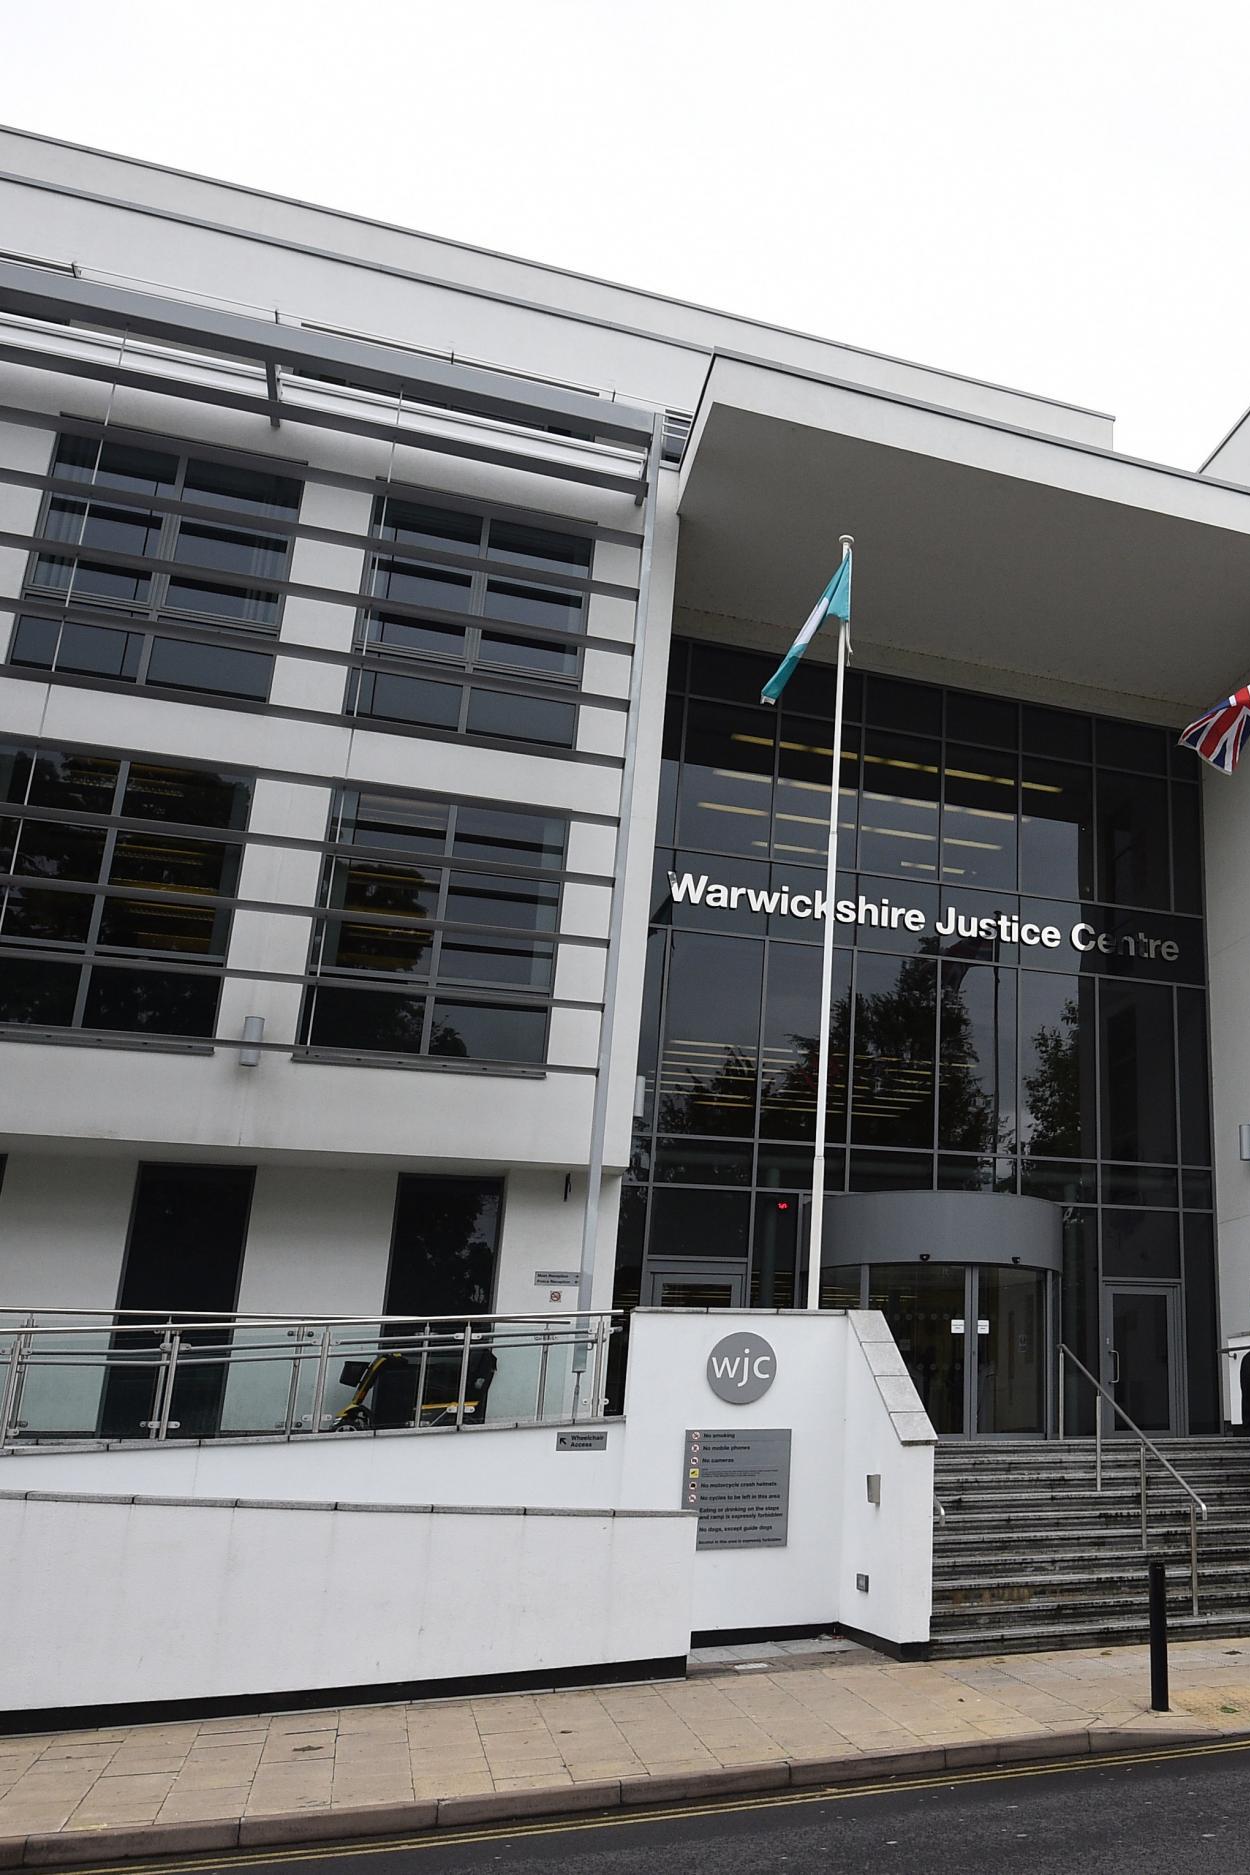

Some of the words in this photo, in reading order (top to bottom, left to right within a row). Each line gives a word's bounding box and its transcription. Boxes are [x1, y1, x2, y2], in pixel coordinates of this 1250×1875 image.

[667, 871, 925, 931] Warwickshire
[935, 906, 1061, 948] Justice
[1070, 922, 1180, 961] Centre
[711, 1348, 771, 1387] wjc
